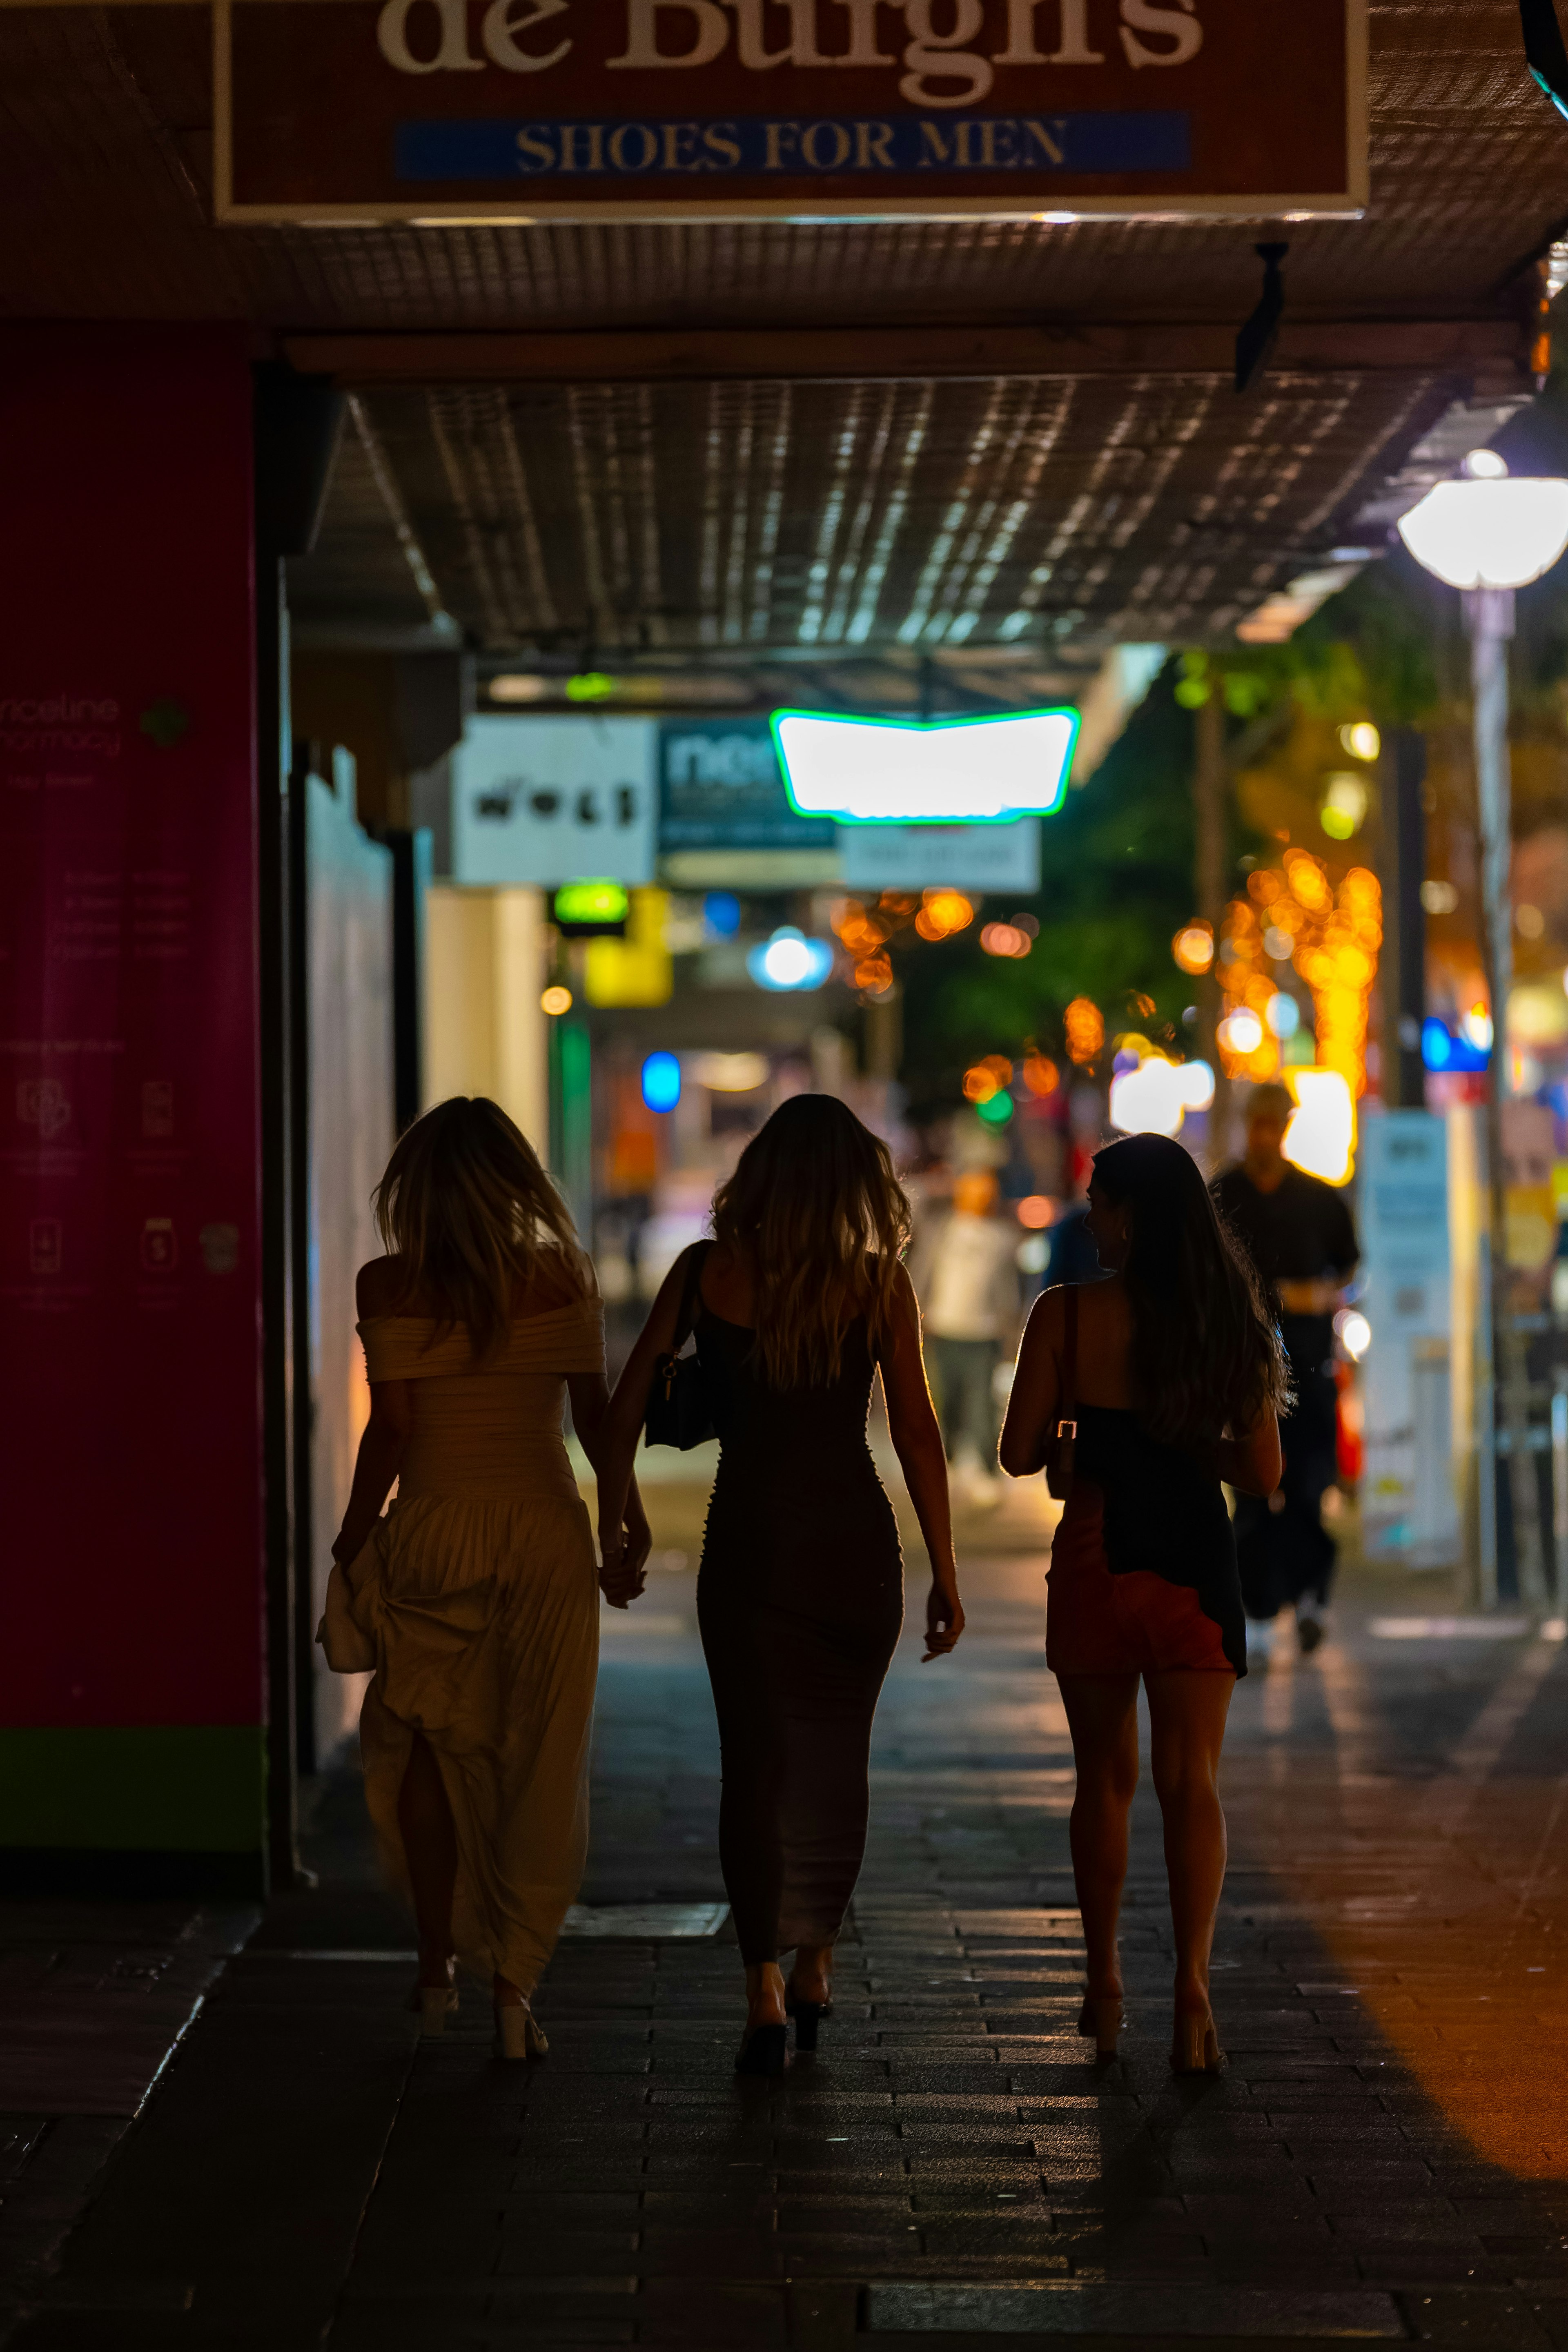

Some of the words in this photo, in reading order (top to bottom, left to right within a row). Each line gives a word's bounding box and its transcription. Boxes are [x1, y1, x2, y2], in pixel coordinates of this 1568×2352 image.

[376, 0, 573, 74] de
[514, 122, 742, 172] SHOES
[762, 120, 895, 169] FOR
[916, 118, 1067, 168] MEN
